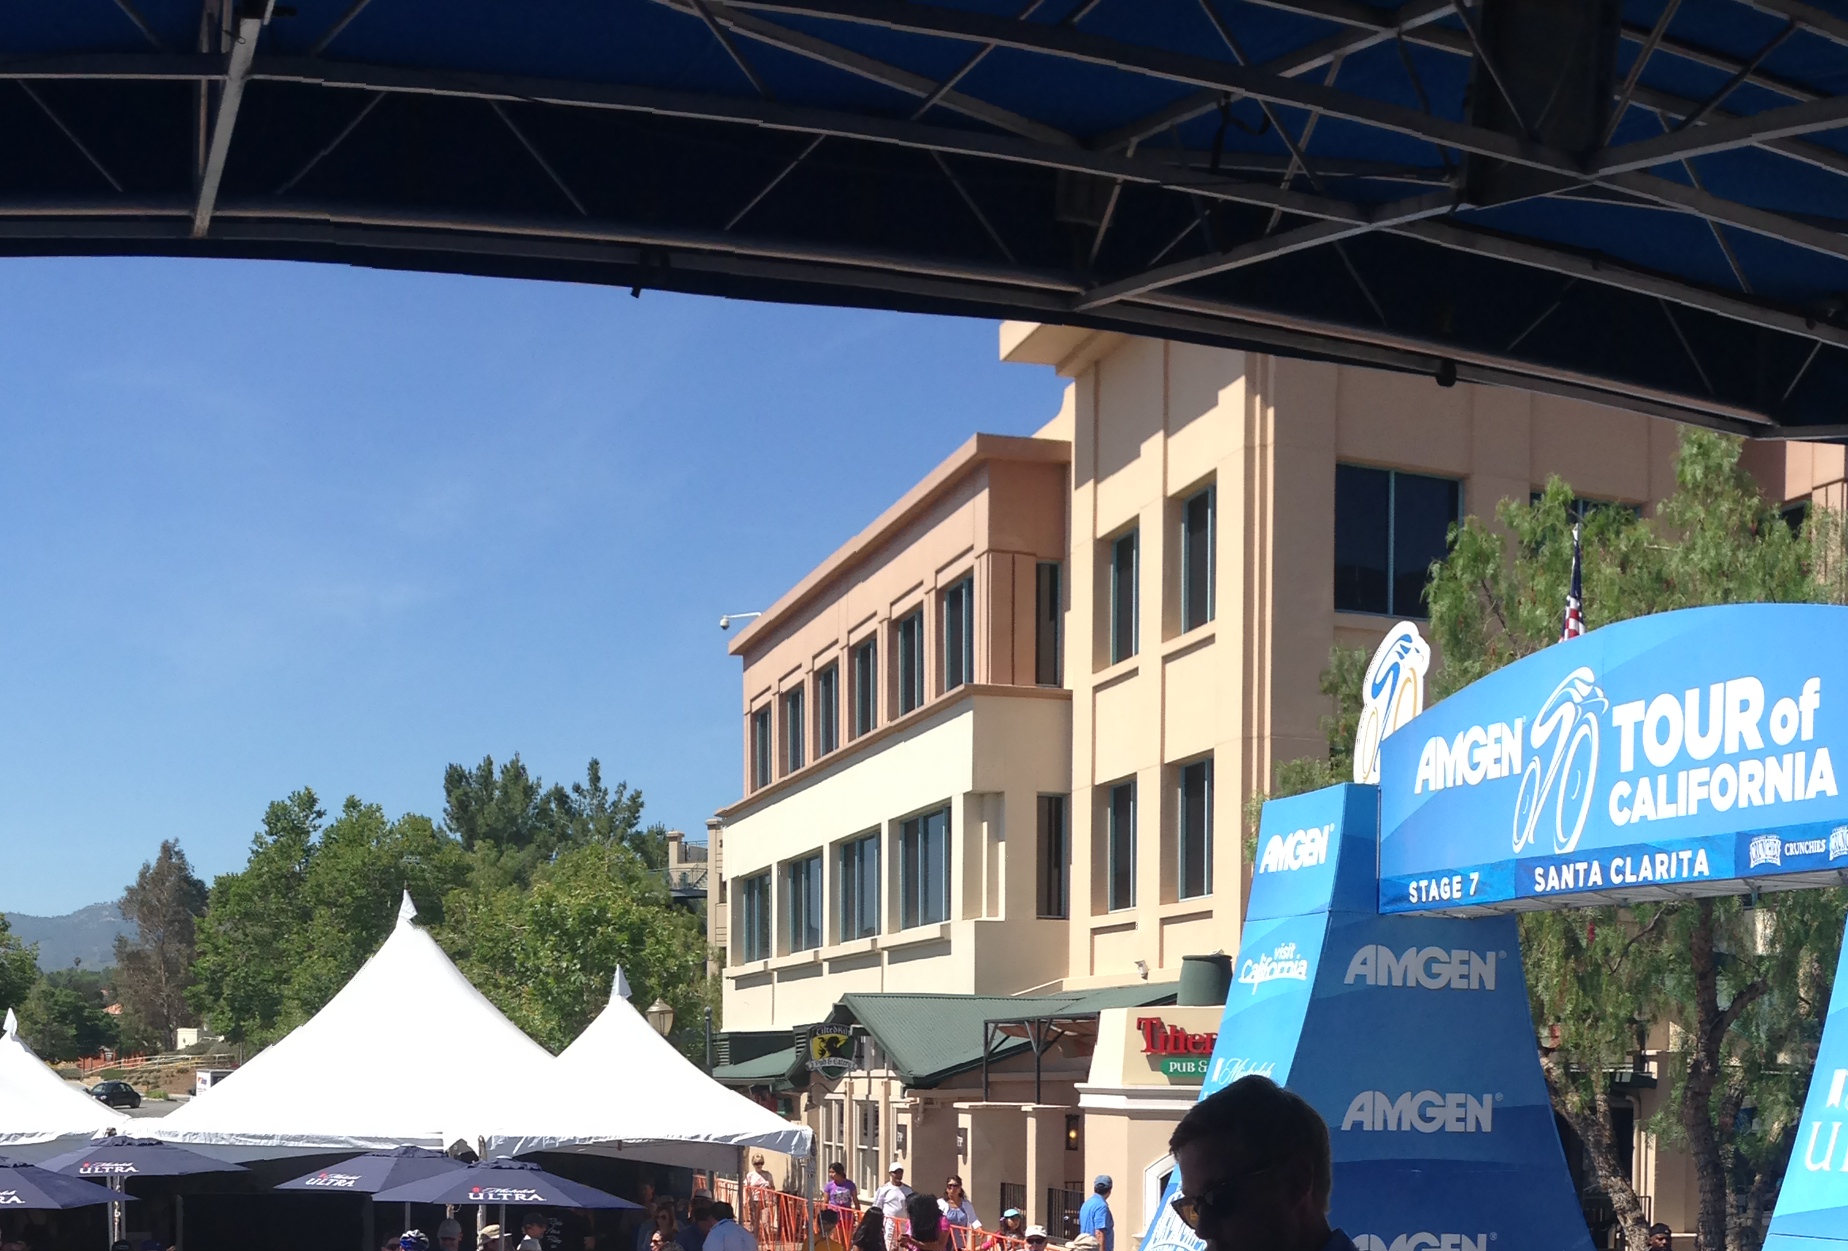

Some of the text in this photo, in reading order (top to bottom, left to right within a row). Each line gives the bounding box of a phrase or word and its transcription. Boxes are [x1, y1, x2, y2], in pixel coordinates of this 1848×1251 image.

[1612, 674, 1821, 773] TOUR of
[1413, 717, 1527, 796] AMGEN
[1608, 746, 1839, 828] CALIFORNIA
[1258, 824, 1330, 875] AMGEN
[1784, 838, 1827, 857] CRUNCHIES
[1408, 871, 1480, 905] STAGE 7
[1534, 848, 1710, 894] SANTA CLARITA
[1238, 951, 1308, 996] California
[1273, 942, 1297, 960] visit
[1343, 944, 1497, 991] AMGEN
[1168, 1060, 1207, 1073] PUB &
[1341, 1090, 1494, 1134] AMGEN
[468, 1192, 545, 1200] ULTRA
